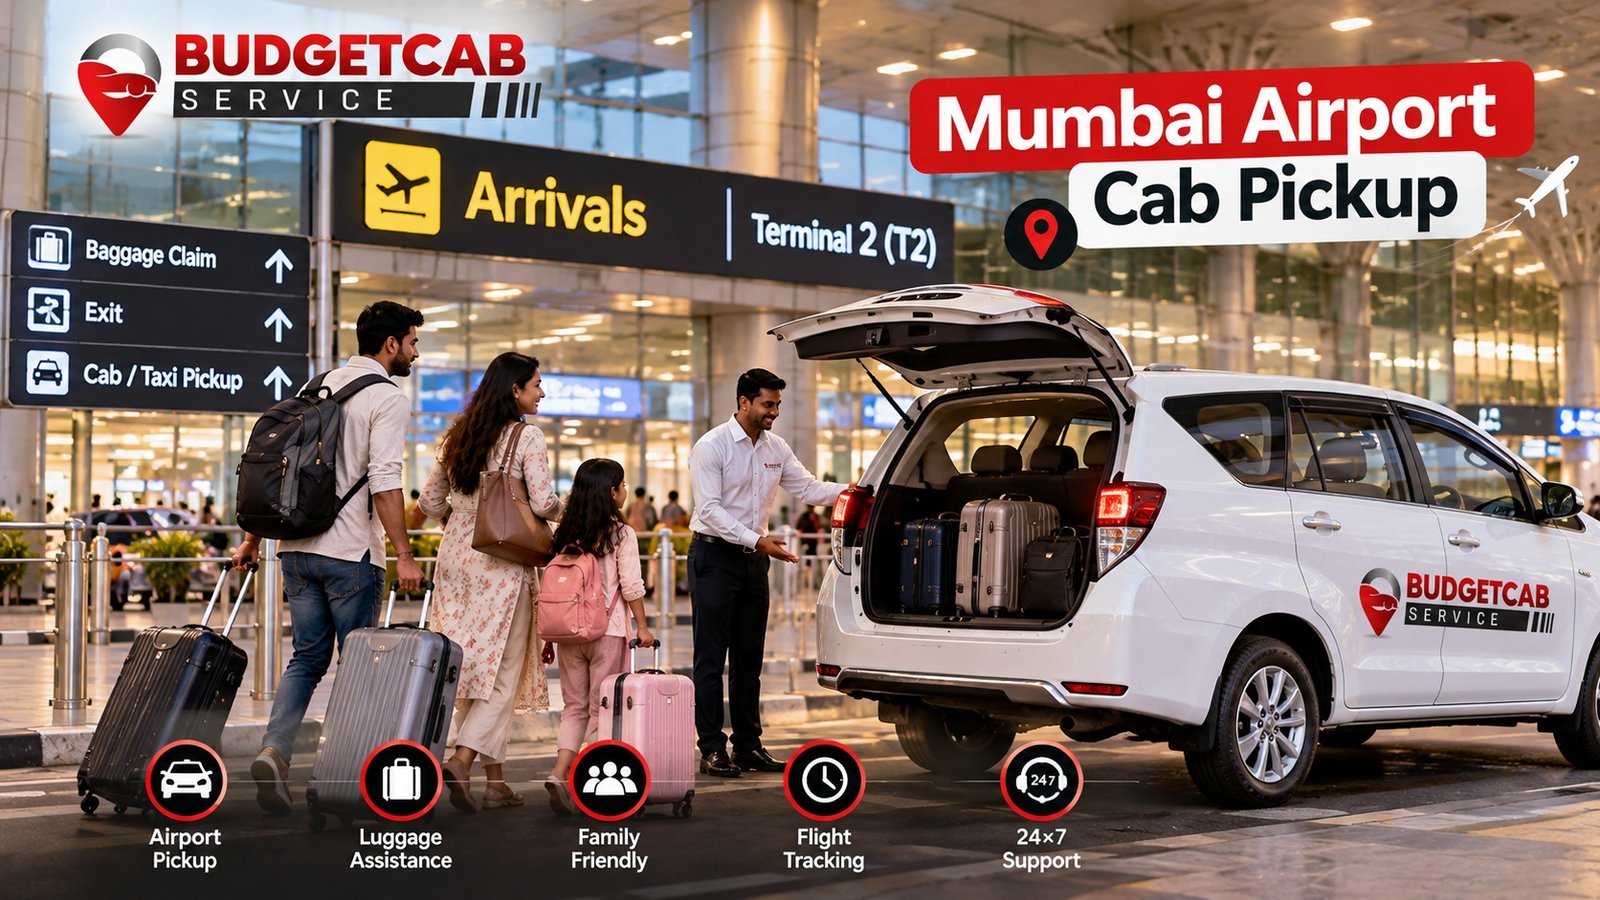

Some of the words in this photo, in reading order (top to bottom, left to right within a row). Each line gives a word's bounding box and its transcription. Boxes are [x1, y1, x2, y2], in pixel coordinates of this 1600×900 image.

[464, 170, 648, 237] Arrivals
[85, 239, 165, 268] Baggage
[168, 245, 217, 269] Claim
[751, 212, 853, 254] Terminal
[858, 221, 878, 257] 2
[884, 223, 937, 270] (T2)
[85, 301, 124, 324] Exit
[83, 363, 123, 386] Cab
[127, 364, 139, 387] /
[140, 365, 178, 388] Taxi
[182, 366, 243, 395] Pickup
[1406, 572, 1550, 608] BUDGETCAB
[1408, 606, 1499, 627] SERVICE
